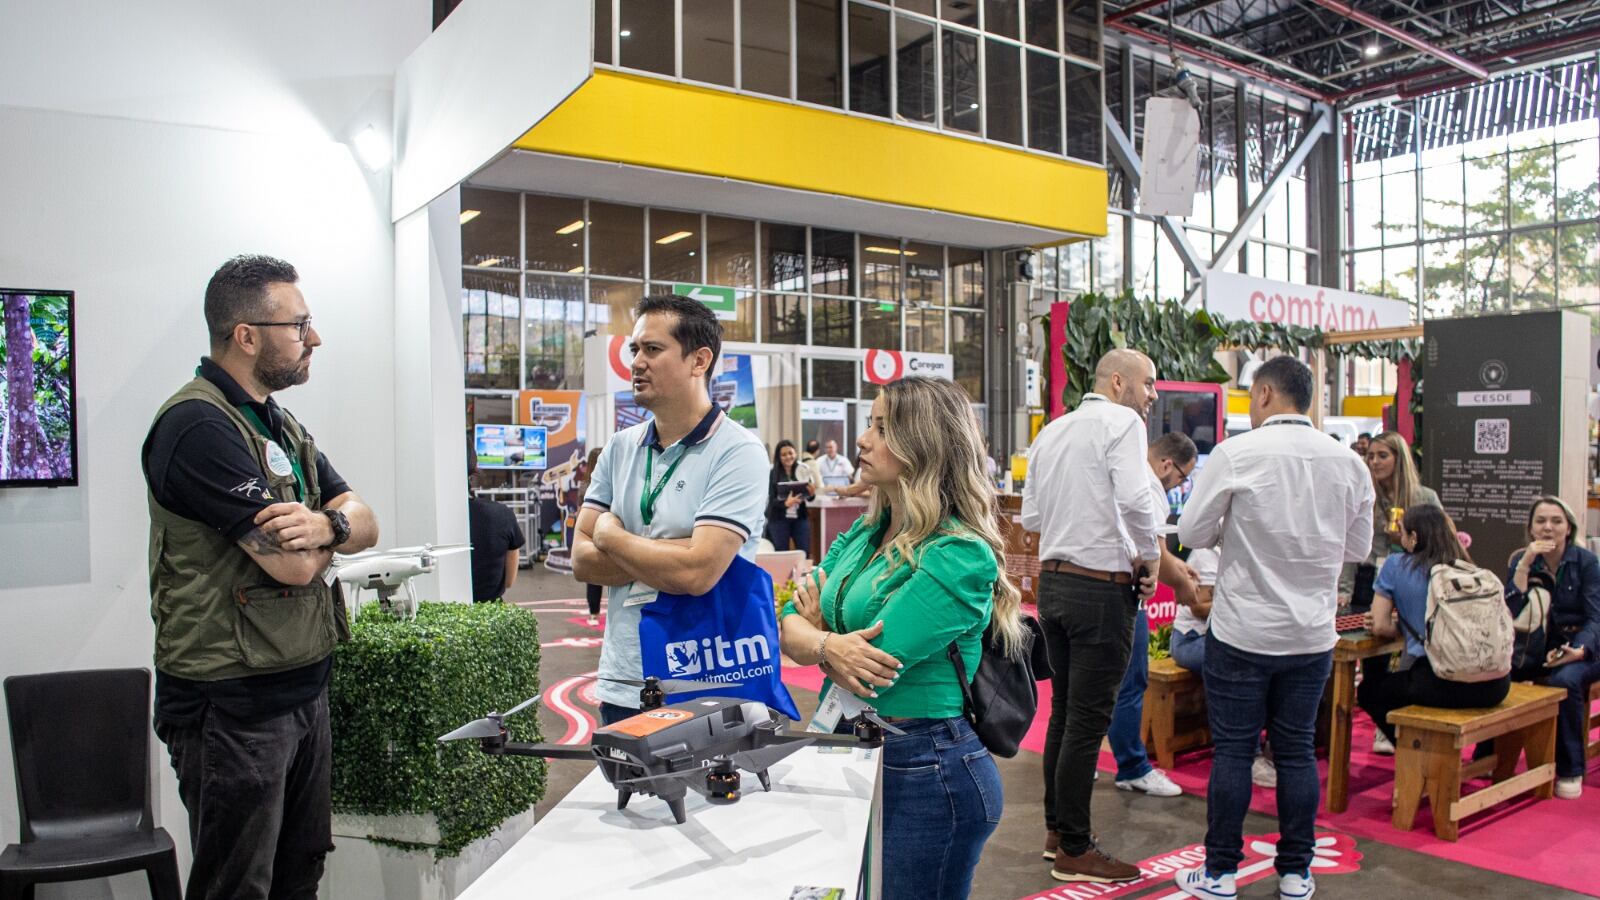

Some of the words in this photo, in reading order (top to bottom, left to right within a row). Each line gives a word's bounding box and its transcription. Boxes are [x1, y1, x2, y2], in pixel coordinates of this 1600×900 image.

[909, 358, 944, 371] Coregan
[1474, 393, 1513, 403] CESDE
[702, 634, 771, 671] itm
[691, 665, 773, 683] itmcol.com
